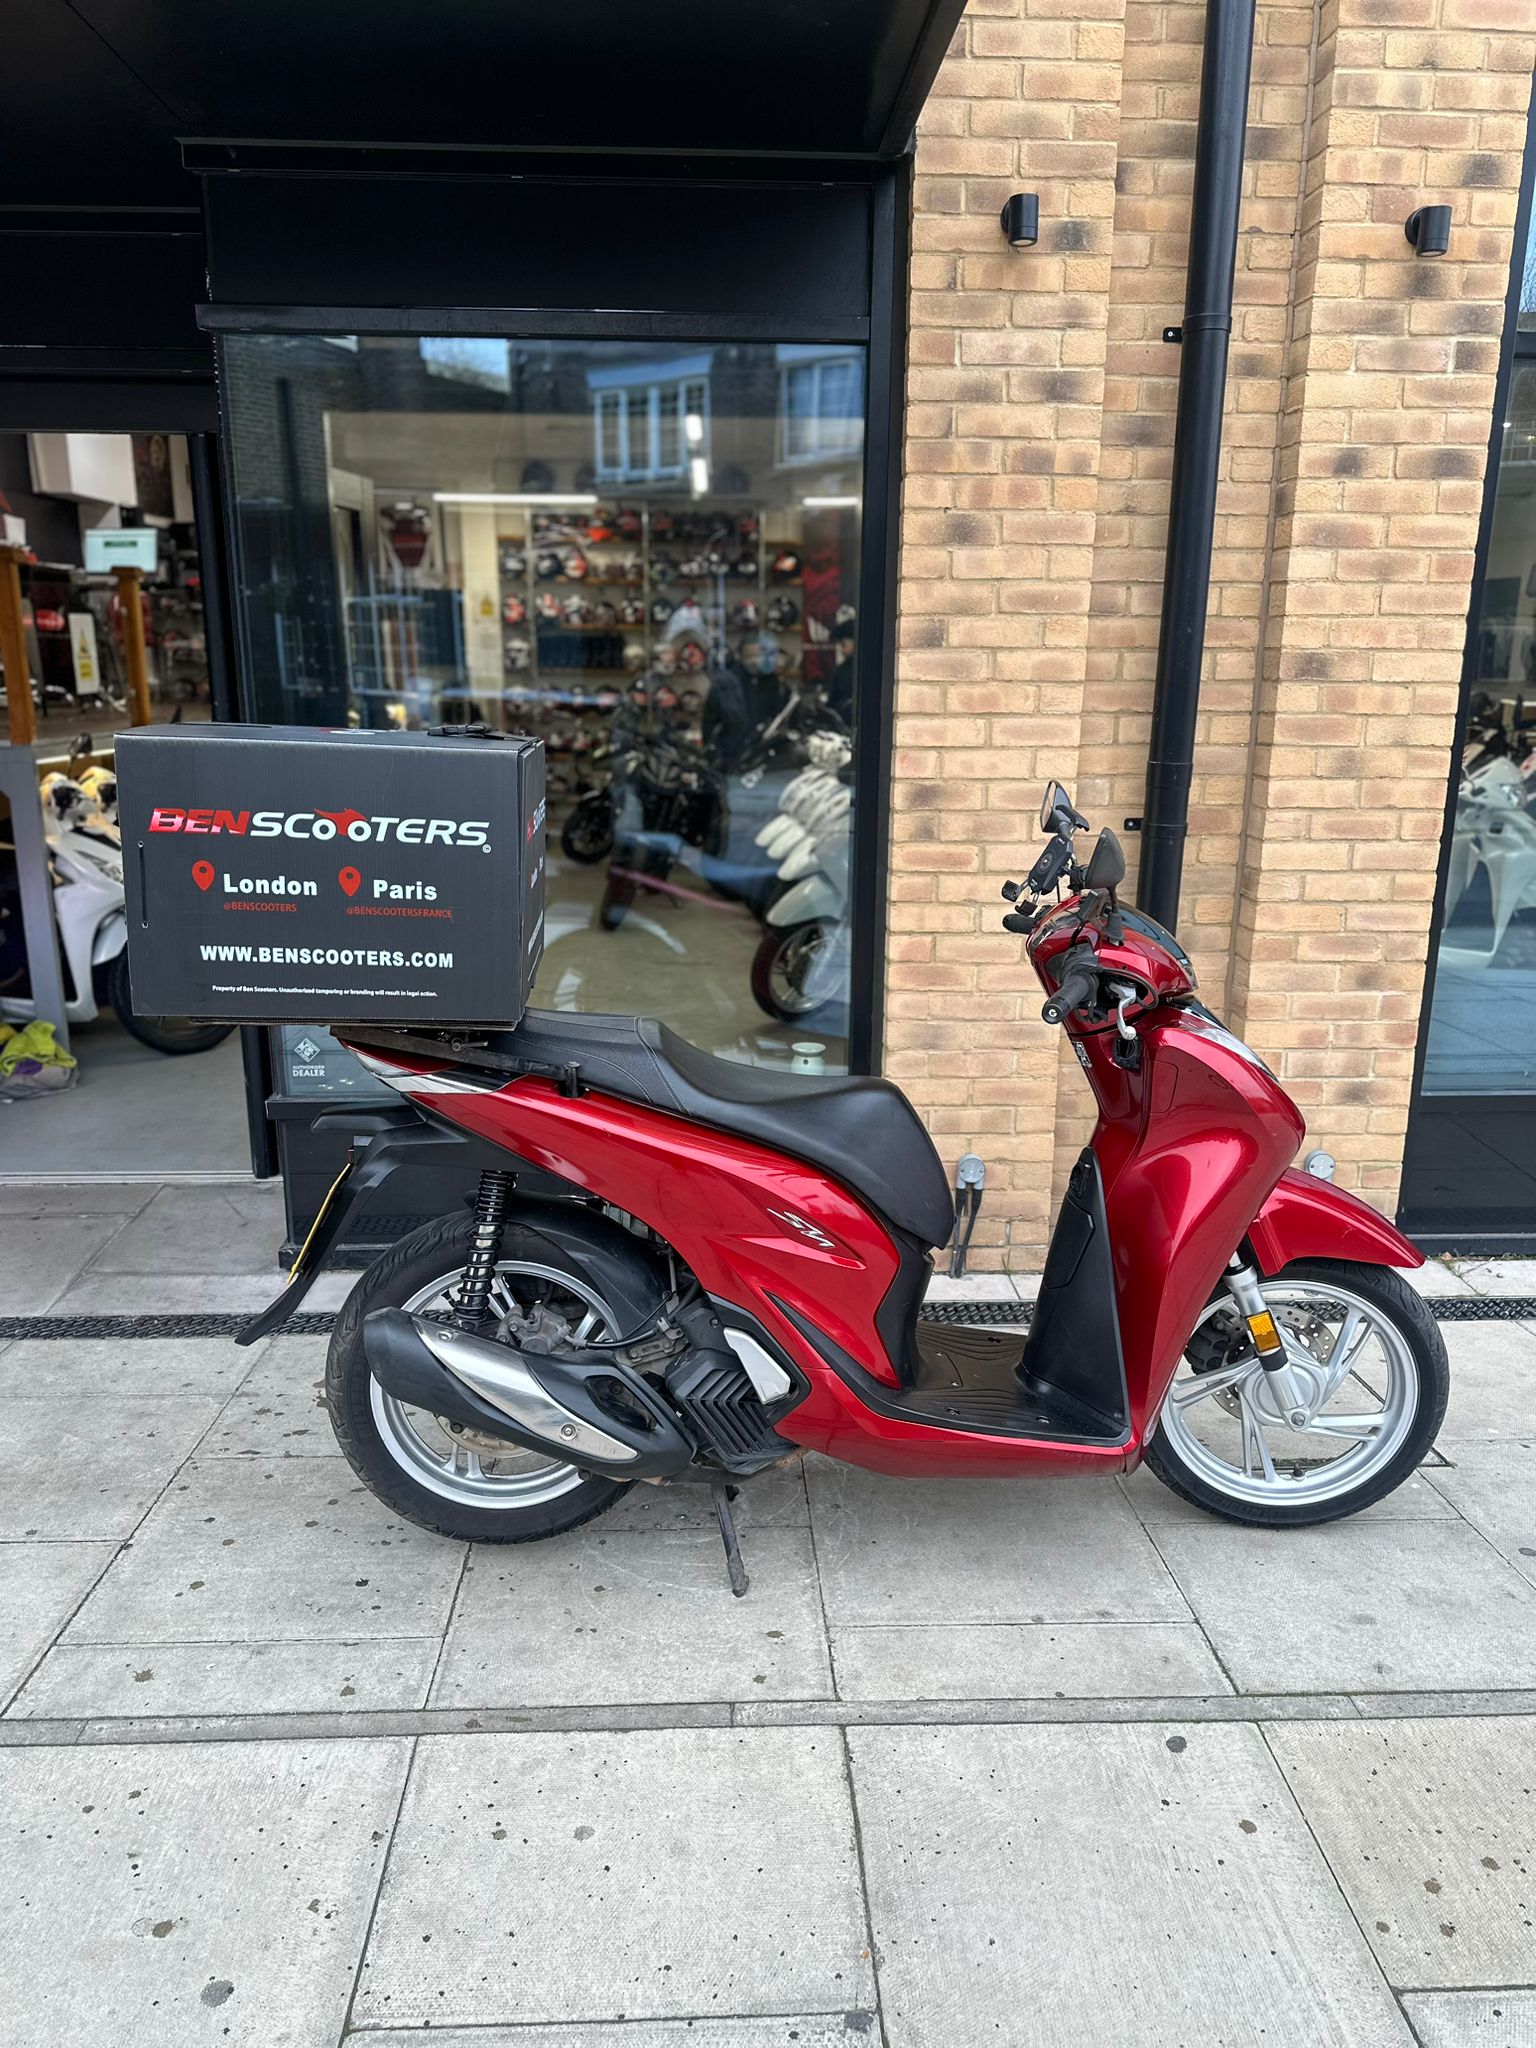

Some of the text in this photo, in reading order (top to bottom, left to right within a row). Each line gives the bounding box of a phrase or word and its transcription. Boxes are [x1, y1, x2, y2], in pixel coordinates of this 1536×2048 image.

[222, 872, 319, 897] London
[372, 879, 439, 902] Paris
[223, 901, 298, 914] @BENSCOOTERS
[346, 906, 454, 920] @BENSCOOTERSFRANCE
[199, 944, 455, 969] WWW.BENSCOOTERS.COM
[212, 985, 235, 993] Property
[292, 1069, 326, 1077] DEALER
